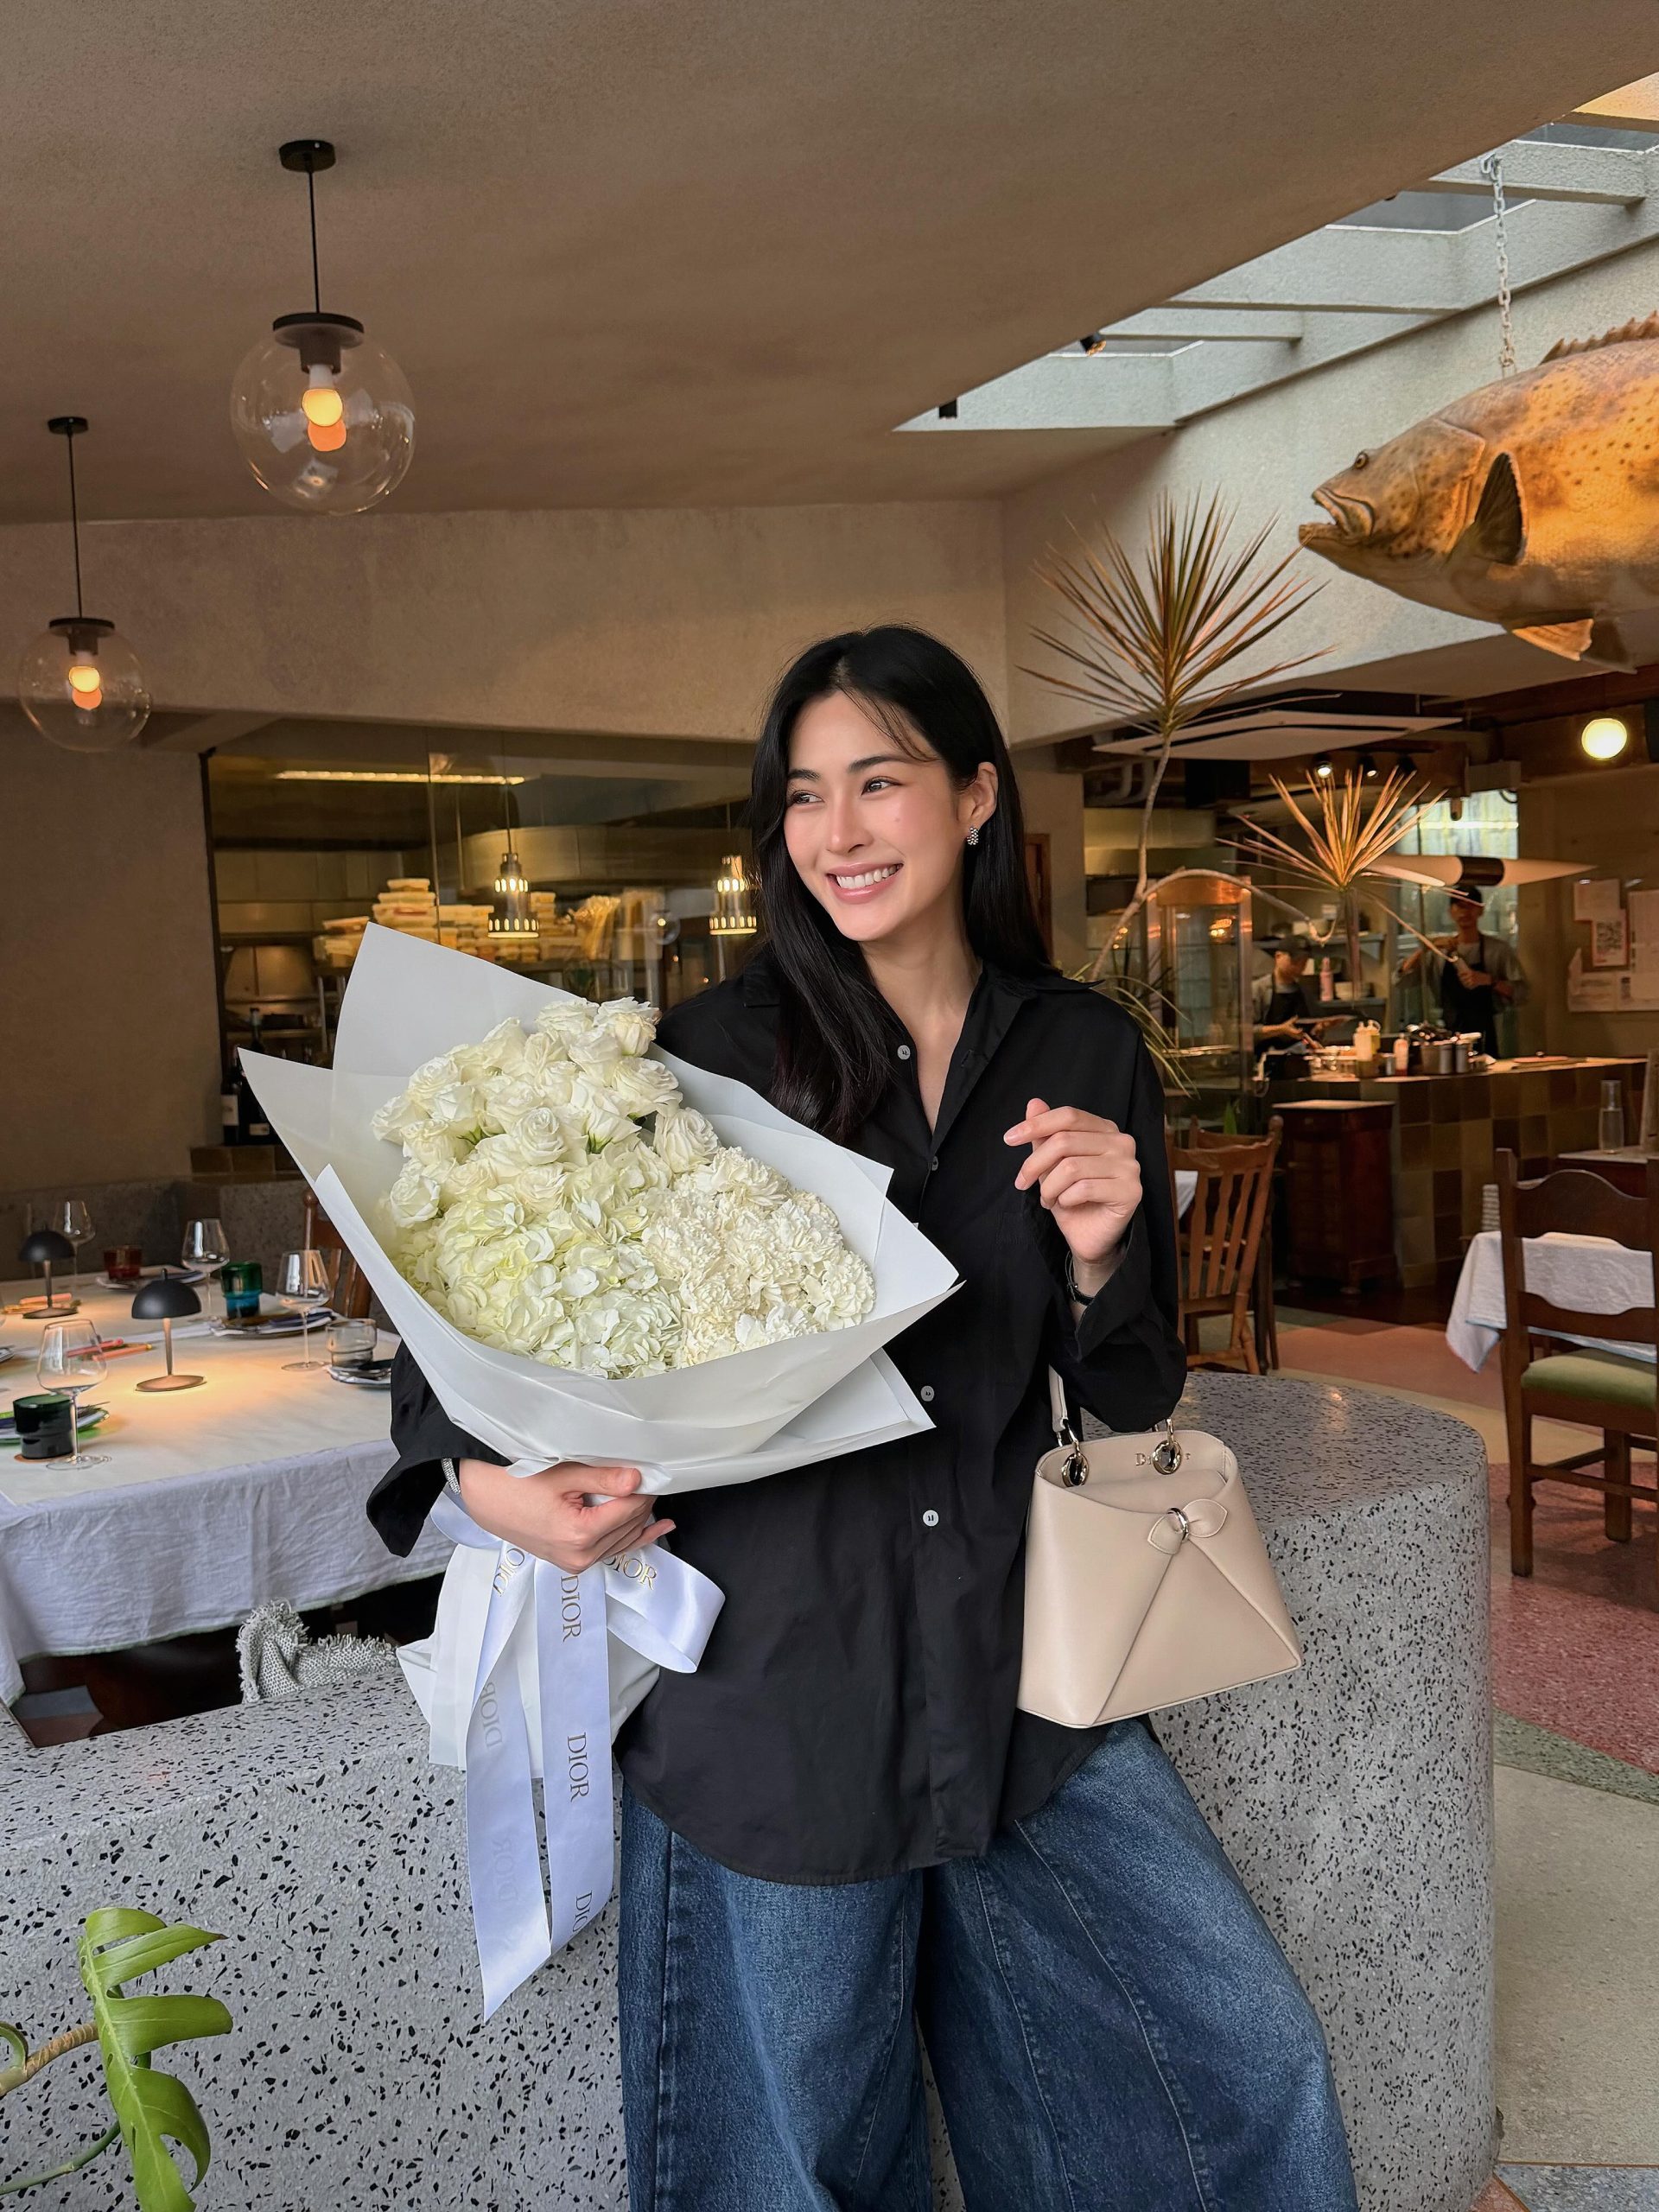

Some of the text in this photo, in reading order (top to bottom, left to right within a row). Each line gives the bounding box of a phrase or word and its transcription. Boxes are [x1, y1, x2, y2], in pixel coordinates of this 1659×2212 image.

[493, 1548, 525, 1598] DIO
[560, 1575, 582, 1643] DIOR
[567, 1732, 590, 1803] DIOR
[572, 1890, 593, 1933] DIO
